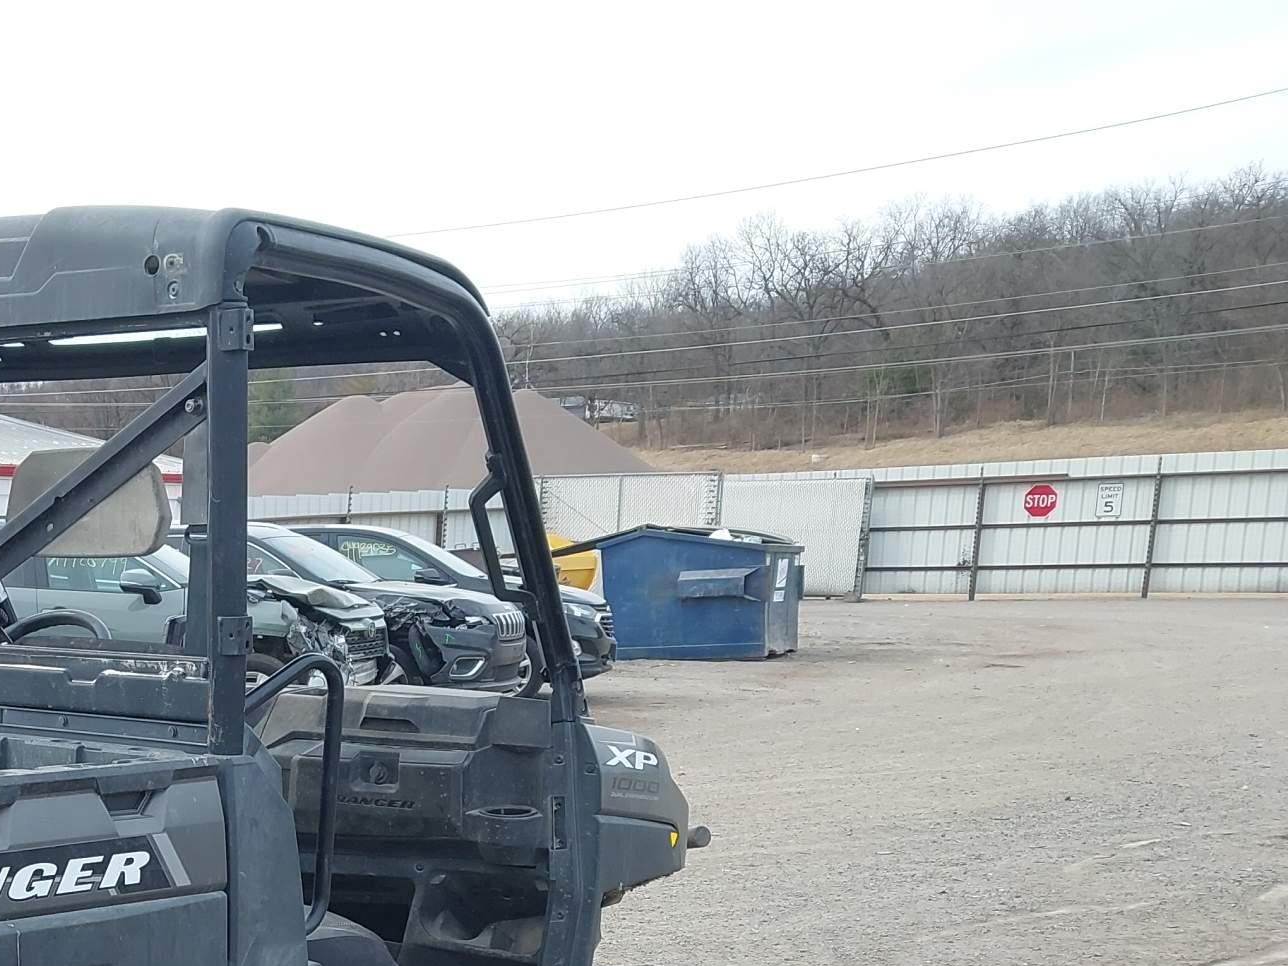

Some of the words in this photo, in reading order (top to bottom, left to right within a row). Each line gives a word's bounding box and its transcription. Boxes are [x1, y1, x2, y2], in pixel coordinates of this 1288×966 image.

[1025, 494, 1057, 508] STOP
[1103, 500, 1114, 513] 5
[605, 744, 658, 770] XP
